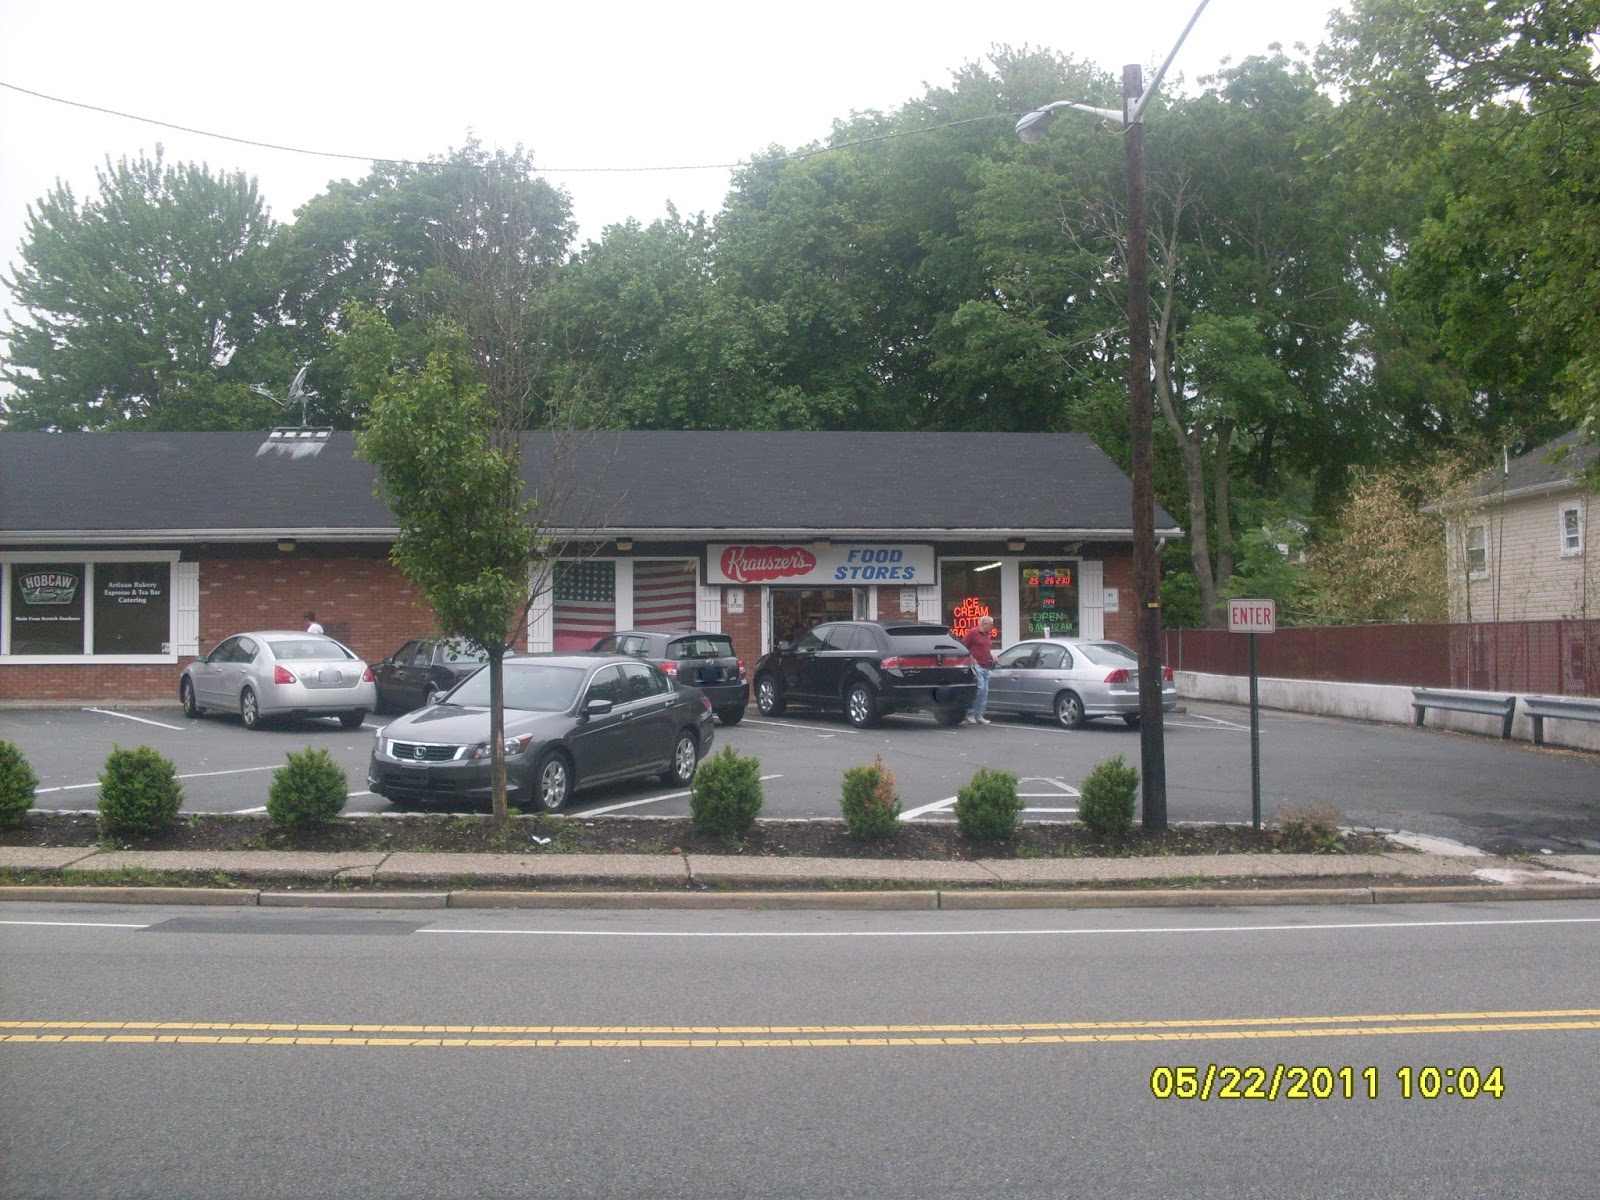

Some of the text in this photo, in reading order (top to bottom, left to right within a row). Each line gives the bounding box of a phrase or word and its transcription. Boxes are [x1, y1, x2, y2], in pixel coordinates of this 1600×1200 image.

[847, 549, 903, 563] FOOD
[728, 548, 812, 582] Krauszer's
[834, 566, 915, 580] STORES
[25, 574, 73, 589] HOBCAW
[134, 581, 157, 589] Bakery
[963, 597, 979, 608] ICE
[953, 606, 989, 617] CREAM
[1033, 612, 1064, 622] OPEN
[1232, 607, 1271, 625] ENTER
[953, 617, 981, 628] LOTT
[1028, 623, 1034, 632] 6
[1060, 623, 1073, 631] AM
